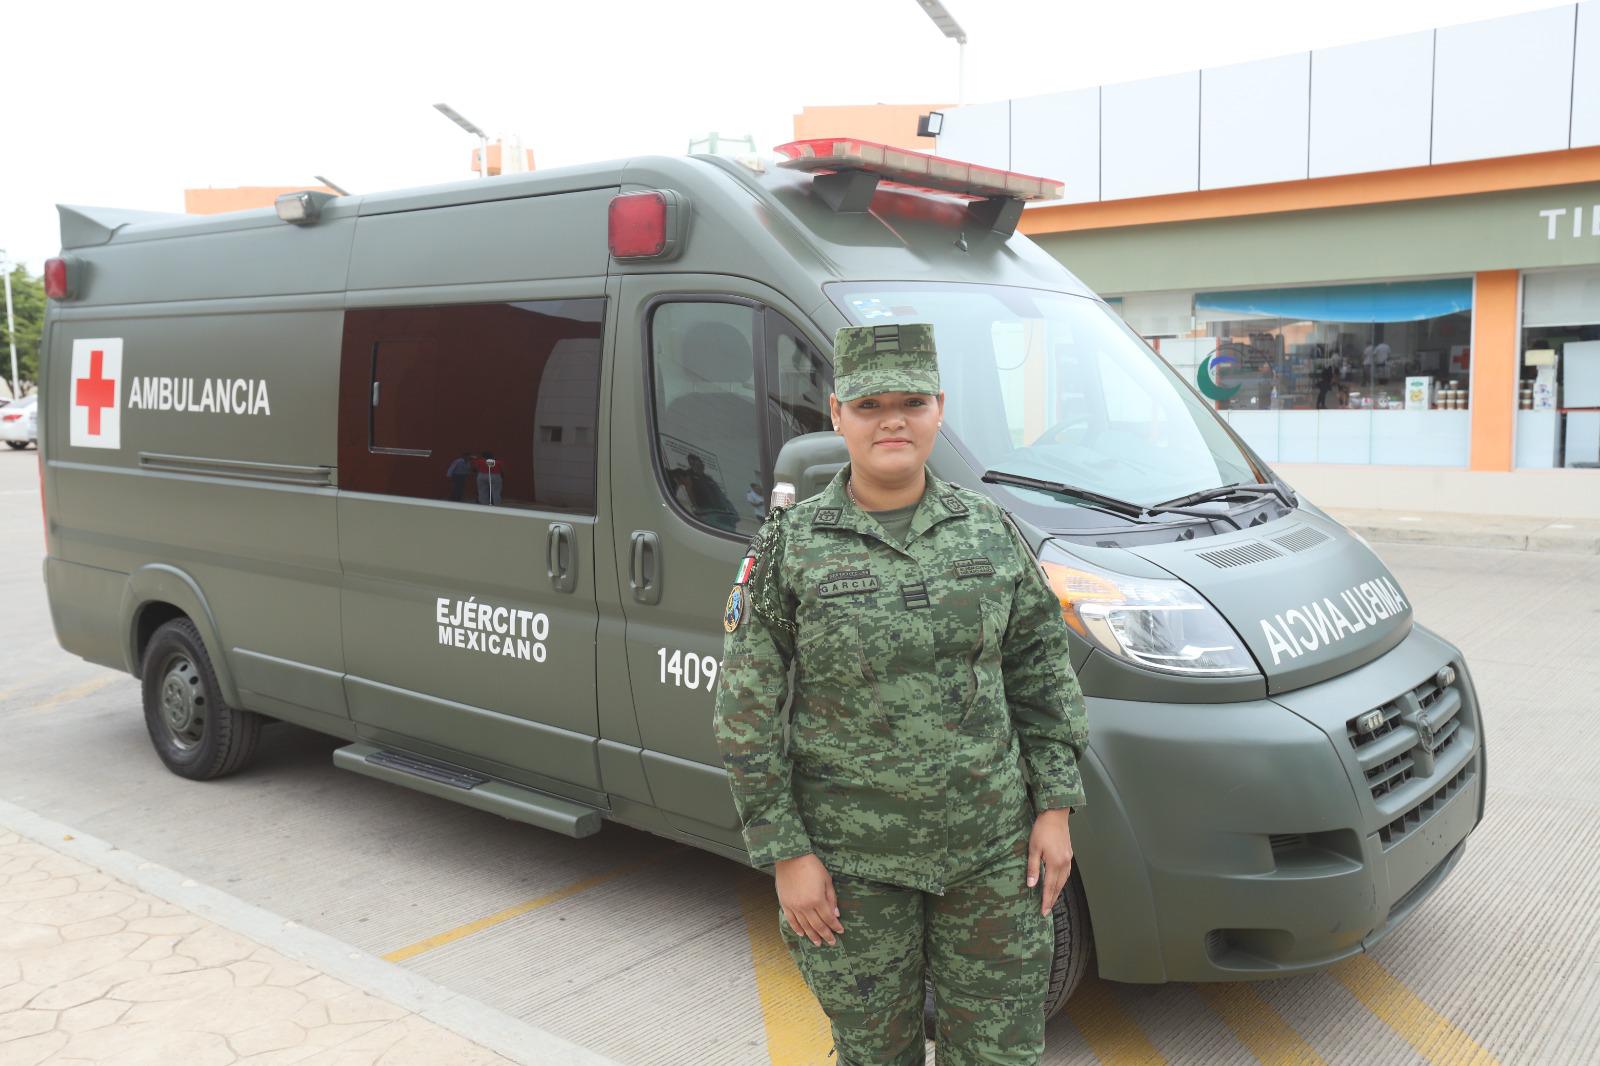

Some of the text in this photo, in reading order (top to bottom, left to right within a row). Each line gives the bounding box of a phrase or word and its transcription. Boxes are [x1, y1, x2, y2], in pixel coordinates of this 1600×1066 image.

[128, 376, 271, 415] AMBULANCIA
[821, 578, 876, 593] GARCIA
[436, 596, 549, 640] EJÉRCITO
[438, 625, 547, 663] MEXICANO
[657, 647, 724, 692] 1409
